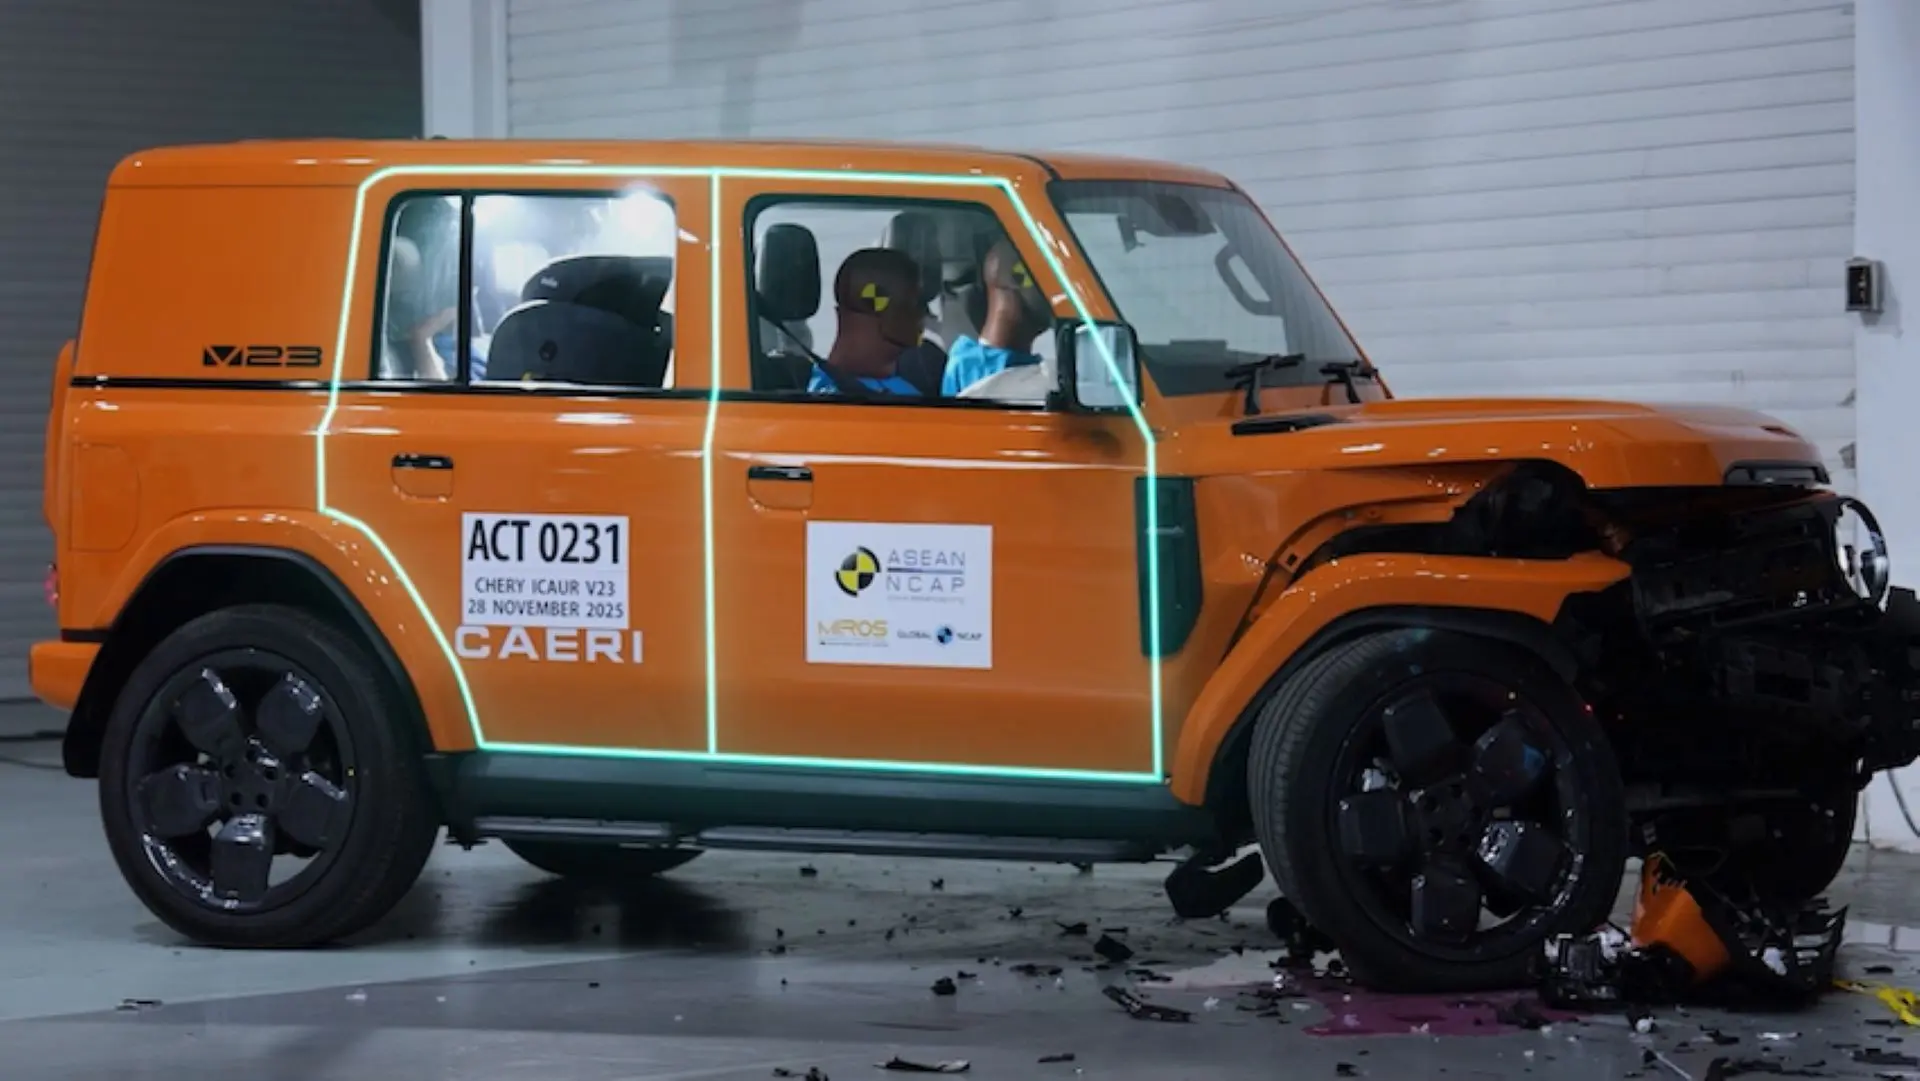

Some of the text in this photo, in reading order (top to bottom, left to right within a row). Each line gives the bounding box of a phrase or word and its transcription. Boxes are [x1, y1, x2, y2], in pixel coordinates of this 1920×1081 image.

[468, 519, 620, 564] ACT 0231
[887, 549, 966, 567] ASEAN
[475, 577, 616, 597] CHERY ICAUR V23
[886, 575, 965, 593] NCAP
[468, 599, 625, 619] 28 NOVEMBER 2025
[455, 626, 643, 663] CAERI
